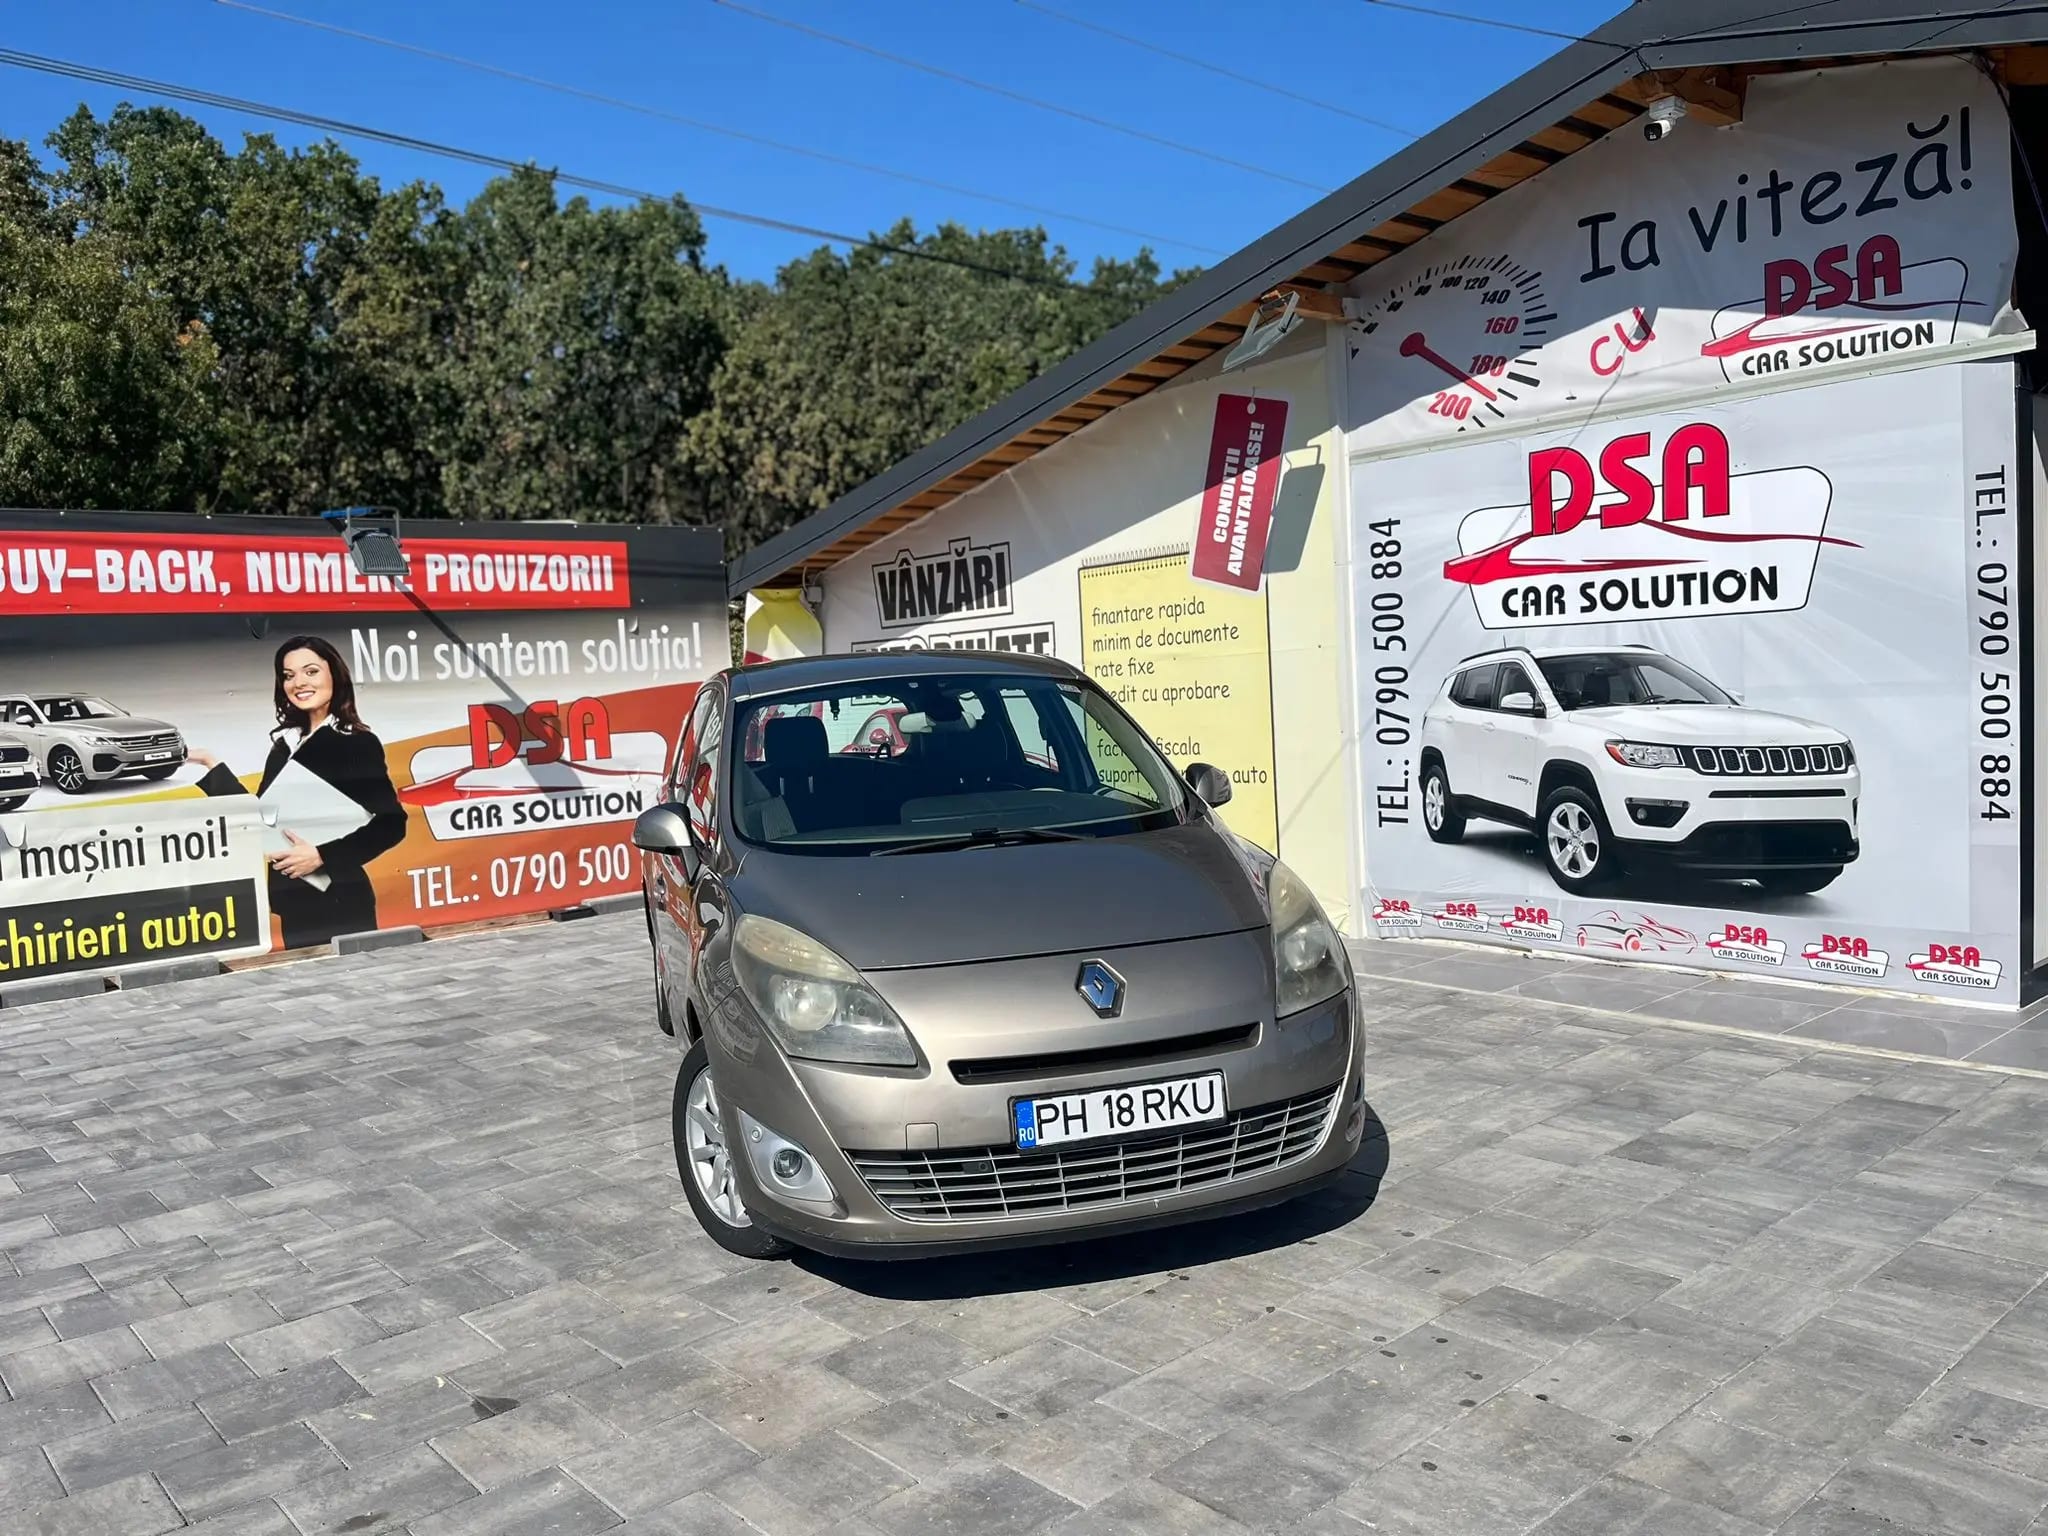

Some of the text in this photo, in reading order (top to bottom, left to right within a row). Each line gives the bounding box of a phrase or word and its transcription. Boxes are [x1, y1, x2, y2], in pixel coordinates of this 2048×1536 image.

[1577, 105, 1973, 283] Ia viteză!
[1440, 275, 1463, 288] 100
[1464, 276, 1490, 290] 120
[1764, 234, 1903, 320] DSA
[1480, 289, 1511, 305] 140
[1484, 316, 1519, 334] 160
[1741, 321, 1934, 376] CAR SOLUTION
[1469, 354, 1507, 377] 180
[1428, 391, 1472, 421] 200
[1528, 422, 1730, 537] DSA
[1213, 447, 1241, 544] CONDITII
[1227, 421, 1264, 577] AVANTAJOASE!
[0, 548, 231, 597] UY-BACK,
[425, 553, 614, 593] PROVIZORII
[877, 546, 1008, 622] VÂNZĂRI
[1502, 565, 1778, 618] CAR SOLUTION
[1092, 596, 1205, 627] finantare rapida
[350, 617, 702, 684] Noi suntem soluția!
[1093, 623, 1239, 652] minim de documente
[1975, 464, 2011, 822] TEL.: 0790 500 884
[1094, 656, 1155, 678] rate fixe
[1369, 518, 1411, 828] TEL.: 0790 500 884
[1142, 687, 1157, 702] cu
[1162, 680, 1230, 706] aprobare
[467, 696, 613, 770] DSA
[1232, 766, 1268, 784] auto
[450, 790, 643, 831] CAR SOLUTION
[20, 826, 146, 883] mașini
[161, 816, 229, 863] noi!
[407, 843, 630, 910] TEL.: 0790 500
[1381, 898, 1410, 913] DSA
[1445, 902, 1478, 918] DSA
[1514, 906, 1549, 924] DSA
[142, 896, 237, 951] auto!
[1526, 930, 1557, 940] SOLUTION
[1725, 924, 1768, 946] DSA
[1717, 949, 1777, 963] CAR SOLUTION
[1822, 934, 1868, 957] DSA
[1929, 944, 1981, 967] DSA
[1815, 961, 1879, 975] CAR SOLUTION
[1921, 971, 1991, 987] CAR SOLUTION
[1036, 1080, 1215, 1140] PH 18 RKU
[1019, 1127, 1035, 1142] RO
